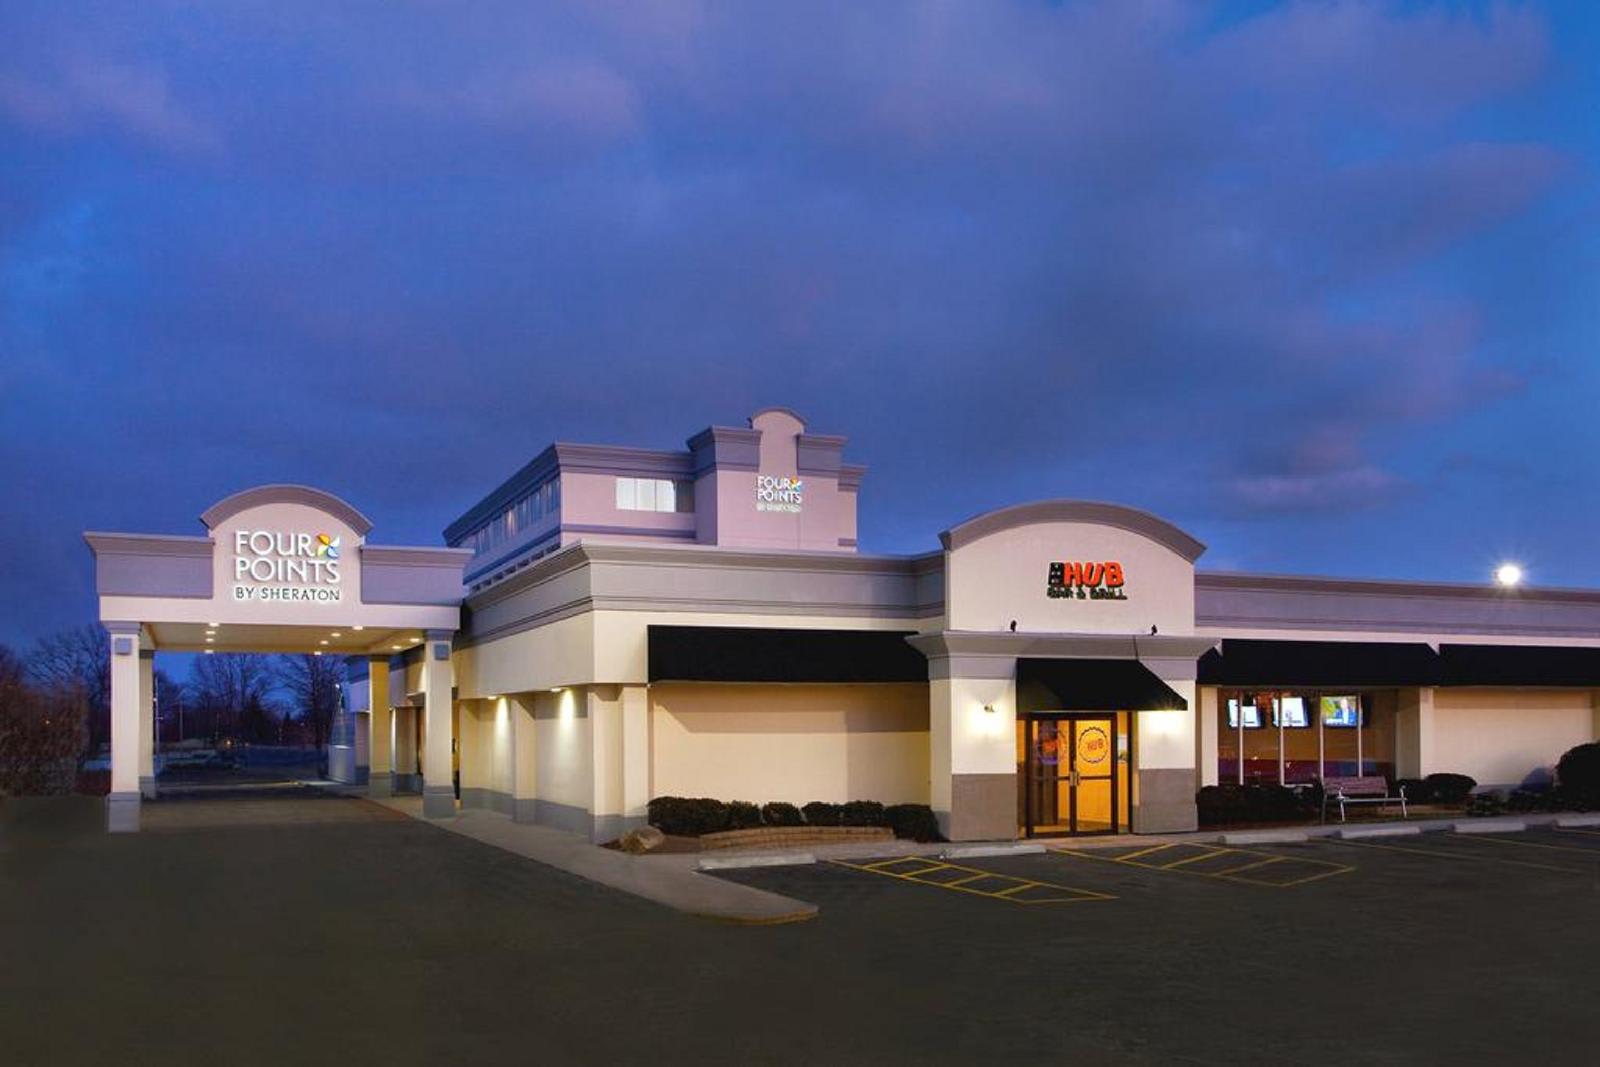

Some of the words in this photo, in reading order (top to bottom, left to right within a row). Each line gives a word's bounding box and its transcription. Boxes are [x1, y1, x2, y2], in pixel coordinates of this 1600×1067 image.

[757, 476, 791, 490] FOUR
[757, 488, 802, 503] POINTS
[235, 530, 315, 557] FOUR
[235, 557, 341, 583] POINTS
[1063, 561, 1124, 588] HUB
[235, 587, 255, 599] BY
[261, 587, 340, 601] SHERATON
